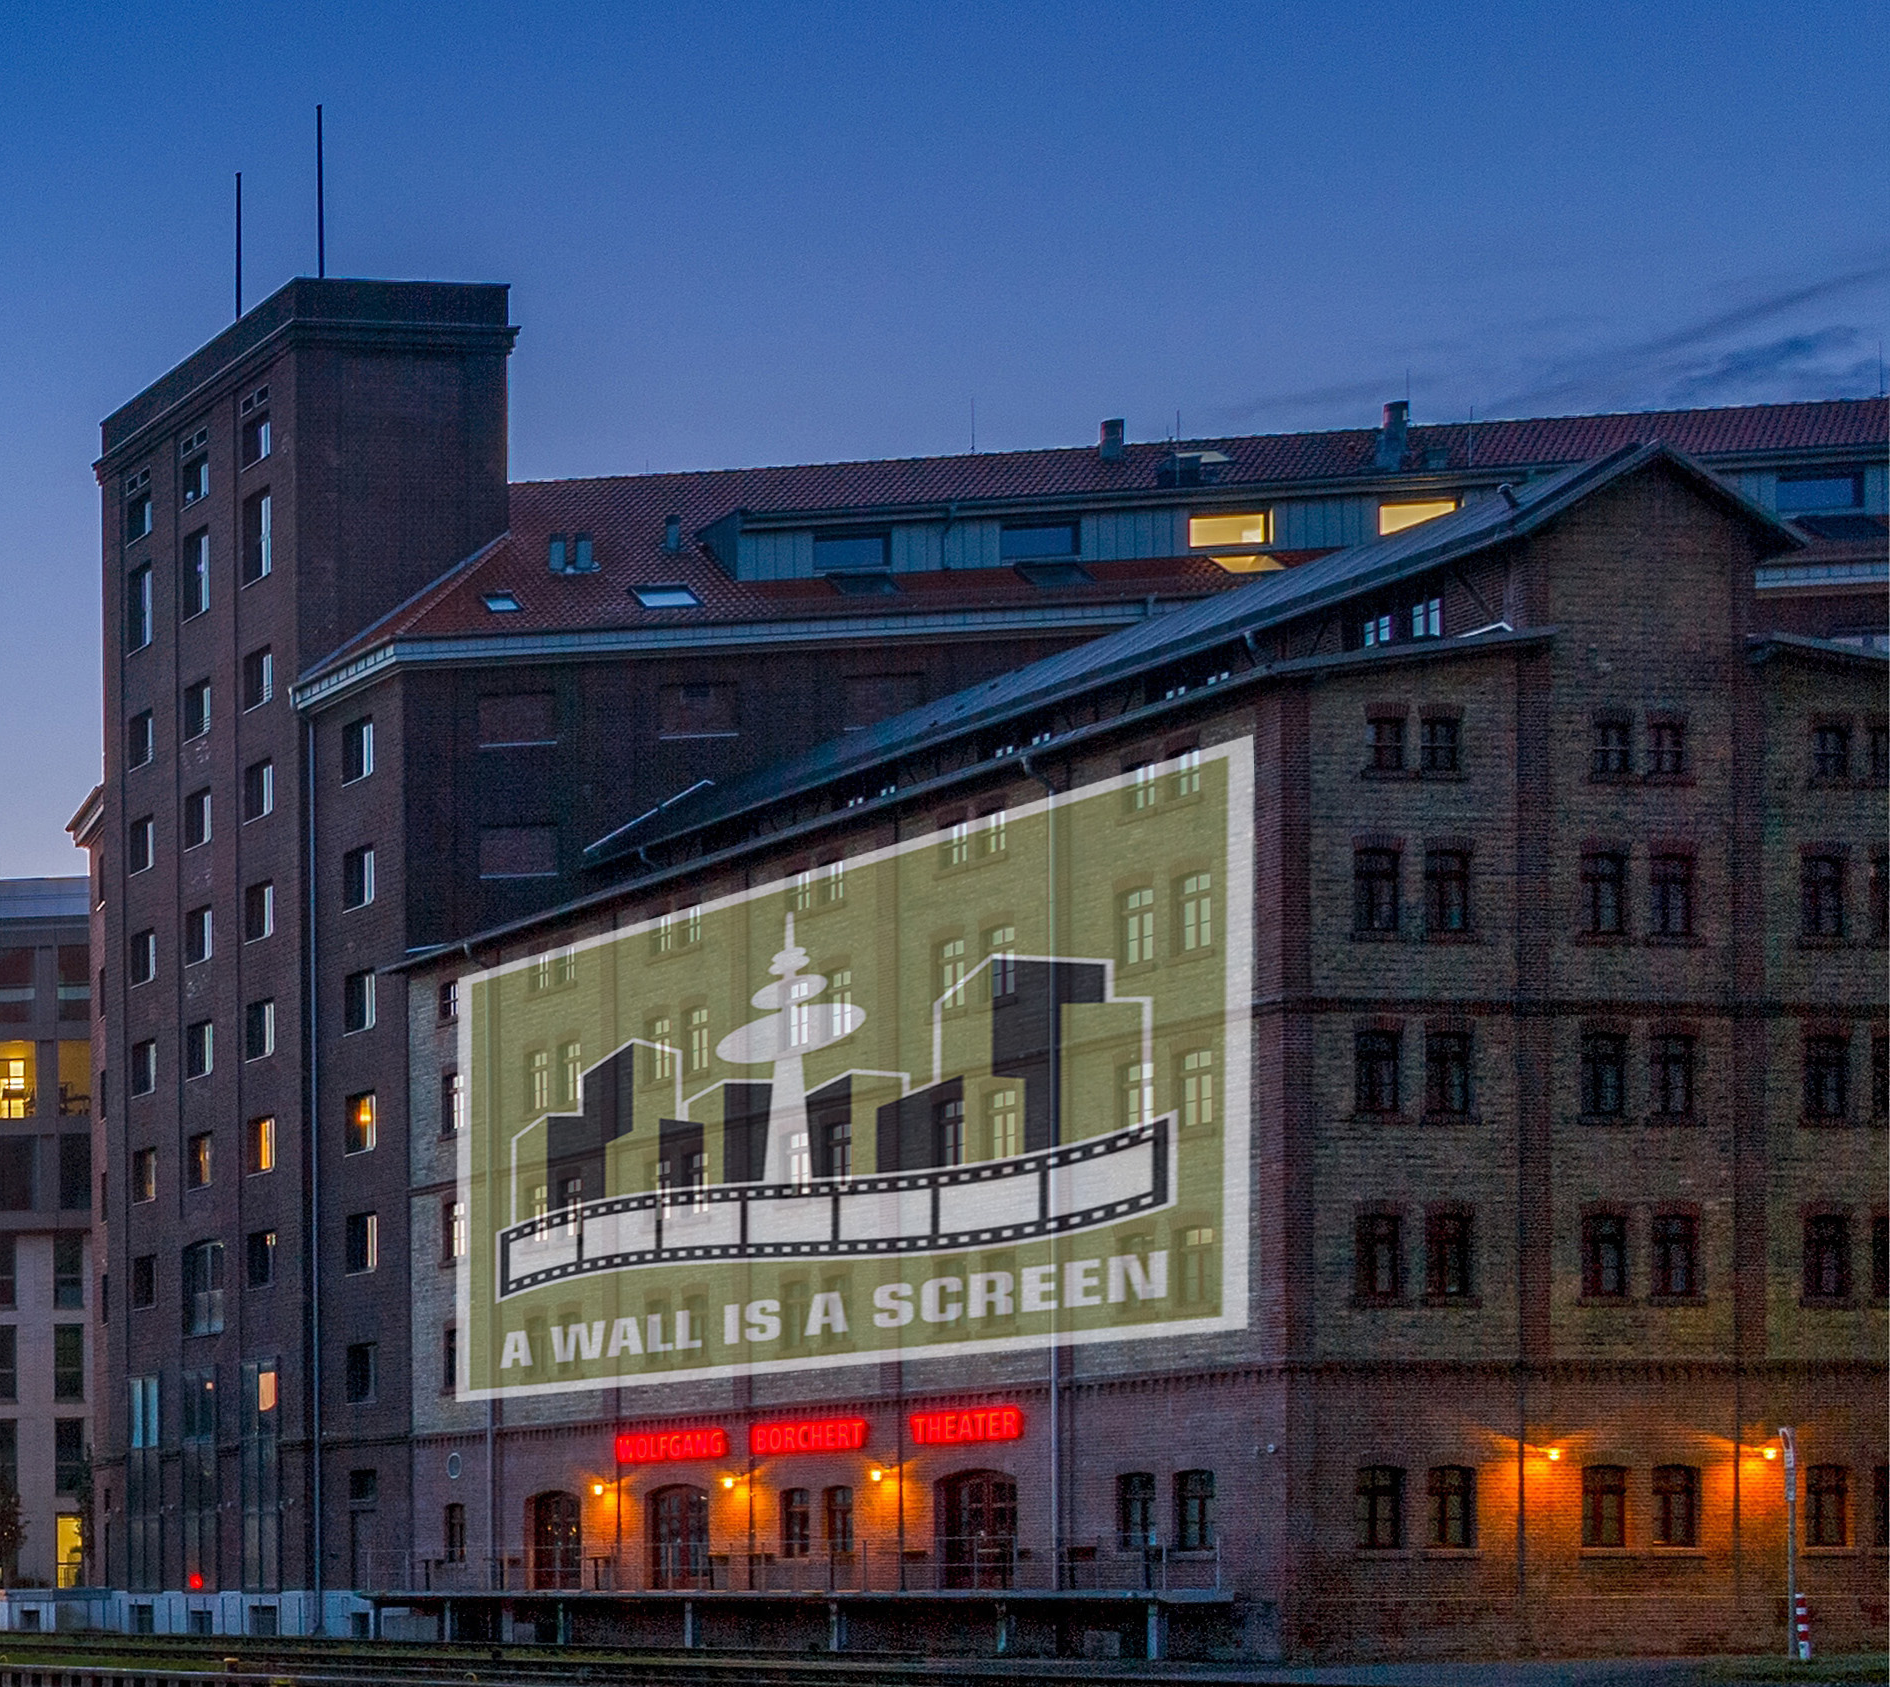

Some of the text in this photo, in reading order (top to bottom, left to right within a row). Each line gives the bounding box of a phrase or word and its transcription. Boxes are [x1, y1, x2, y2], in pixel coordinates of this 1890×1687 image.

[499, 1249, 1170, 1370] A WALL IS A SCREEN
[618, 1410, 1019, 1461] WOLFGANG BORCHERT THEATER
